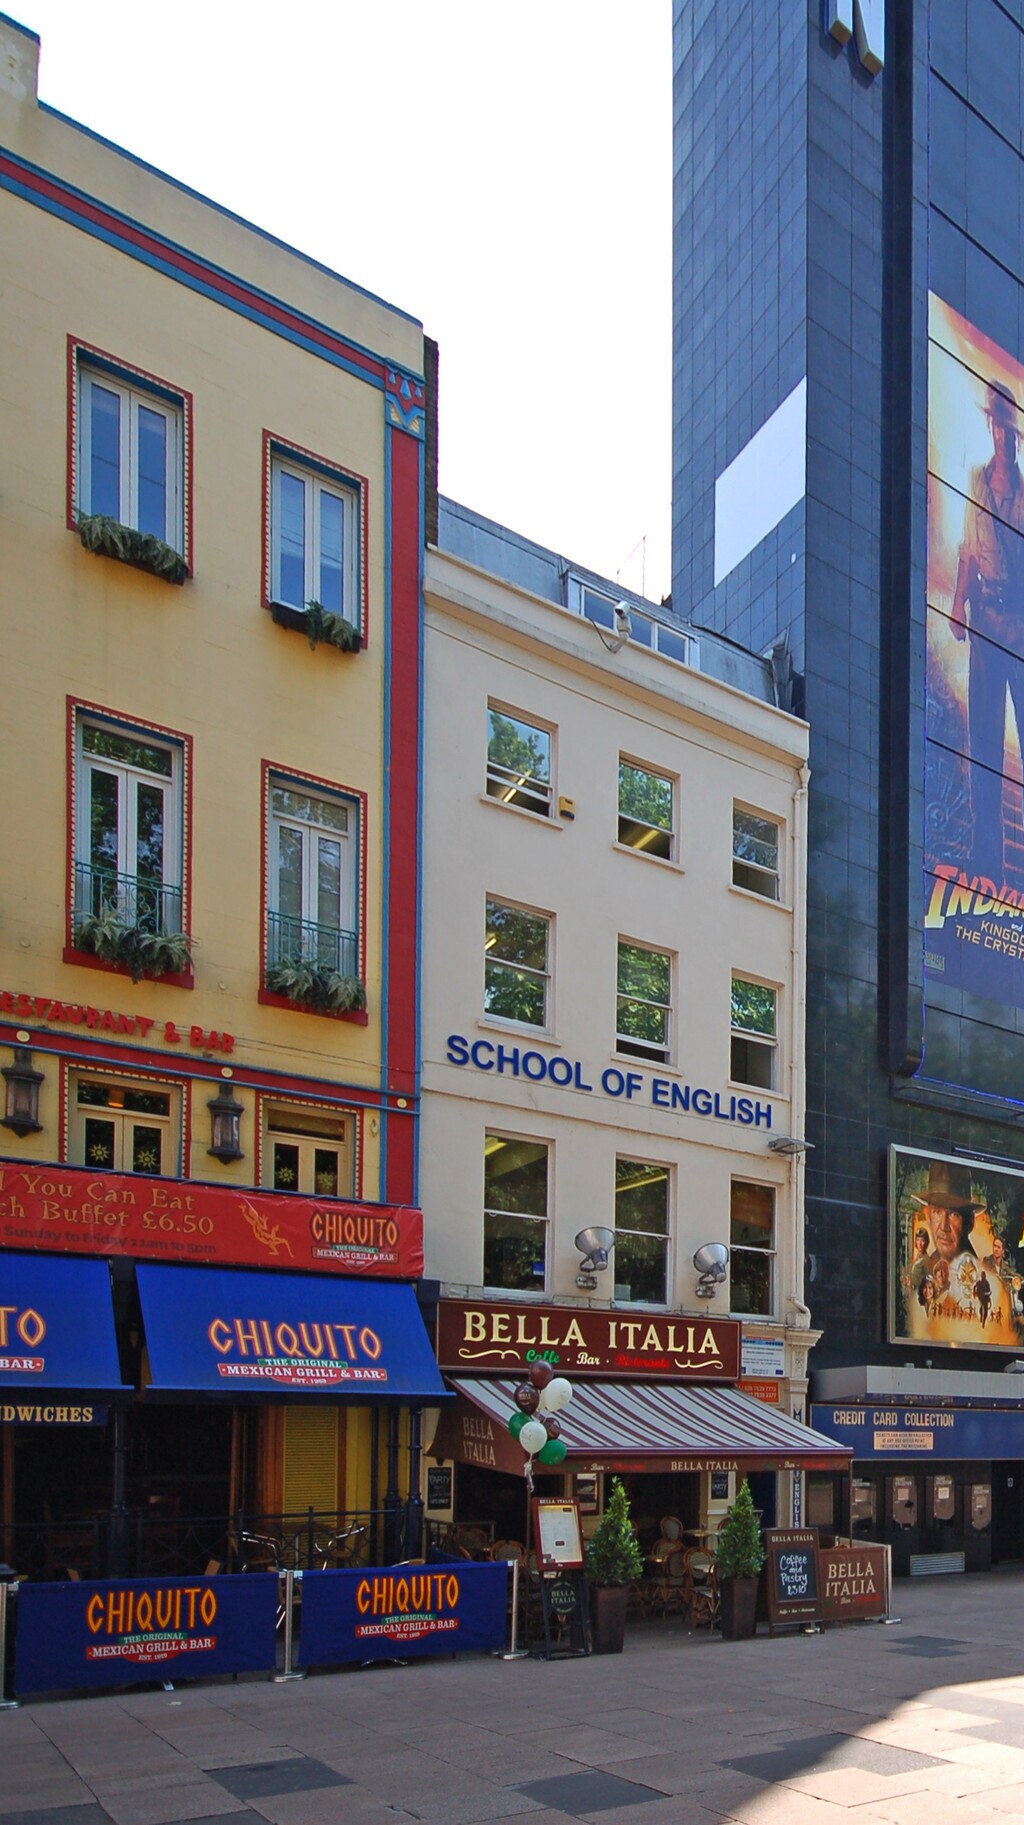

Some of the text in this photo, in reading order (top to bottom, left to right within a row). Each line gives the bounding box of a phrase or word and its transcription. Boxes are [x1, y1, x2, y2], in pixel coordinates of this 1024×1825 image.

[955, 924, 981, 945] THE
[0, 991, 235, 1053] ESTAURANT & BAR
[447, 1034, 772, 1128] SCHOOL OF ENGLISH
[20, 1172, 73, 1199] You
[86, 1182, 136, 1205] Can
[151, 1188, 196, 1211] Eat
[42, 1200, 128, 1227] Buffet
[143, 1213, 214, 1235] £6.50
[4, 1225, 61, 1243] Sunday
[66, 1228, 80, 1241] to
[83, 1231, 127, 1247] Friday
[311, 1213, 398, 1248] CHIQUITO
[317, 1249, 350, 1259] MEXICAN
[351, 1250, 372, 1260] GRILL
[380, 1253, 394, 1261] BAR
[208, 1318, 383, 1360] CHIQUITO
[463, 1310, 720, 1355] BELLA ITALIA
[0, 1358, 35, 1369] BAR
[291, 1359, 342, 1368] ORIGINAL
[576, 1351, 600, 1366] Bar
[227, 1365, 381, 1379] MEXICAN GRILL & BAR
[462, 1416, 494, 1440] BELLA
[833, 1410, 954, 1428] CREDIT CARD COLLECTION
[463, 1440, 496, 1466] ITALIA
[671, 1461, 738, 1471] BELLA ITALIA
[772, 1535, 791, 1543] BELLA
[780, 1555, 808, 1571] Coffee
[828, 1561, 875, 1579] BELLA
[780, 1573, 808, 1586] Pastry
[826, 1579, 876, 1597] ITALIA
[356, 1574, 460, 1614] CHIQUITO
[551, 1590, 575, 1598] BELLA
[551, 1596, 576, 1604] ITALIA
[86, 1588, 218, 1634] CHIQUITO
[384, 1614, 433, 1624] THE ORIGINAL
[360, 1619, 455, 1636] MEXICAN GRILL & BAR
[124, 1632, 184, 1644] THE ORIGINAL
[92, 1638, 212, 1657] MEXICAN GRILL & BAR
[138, 1653, 153, 1661] EST.
